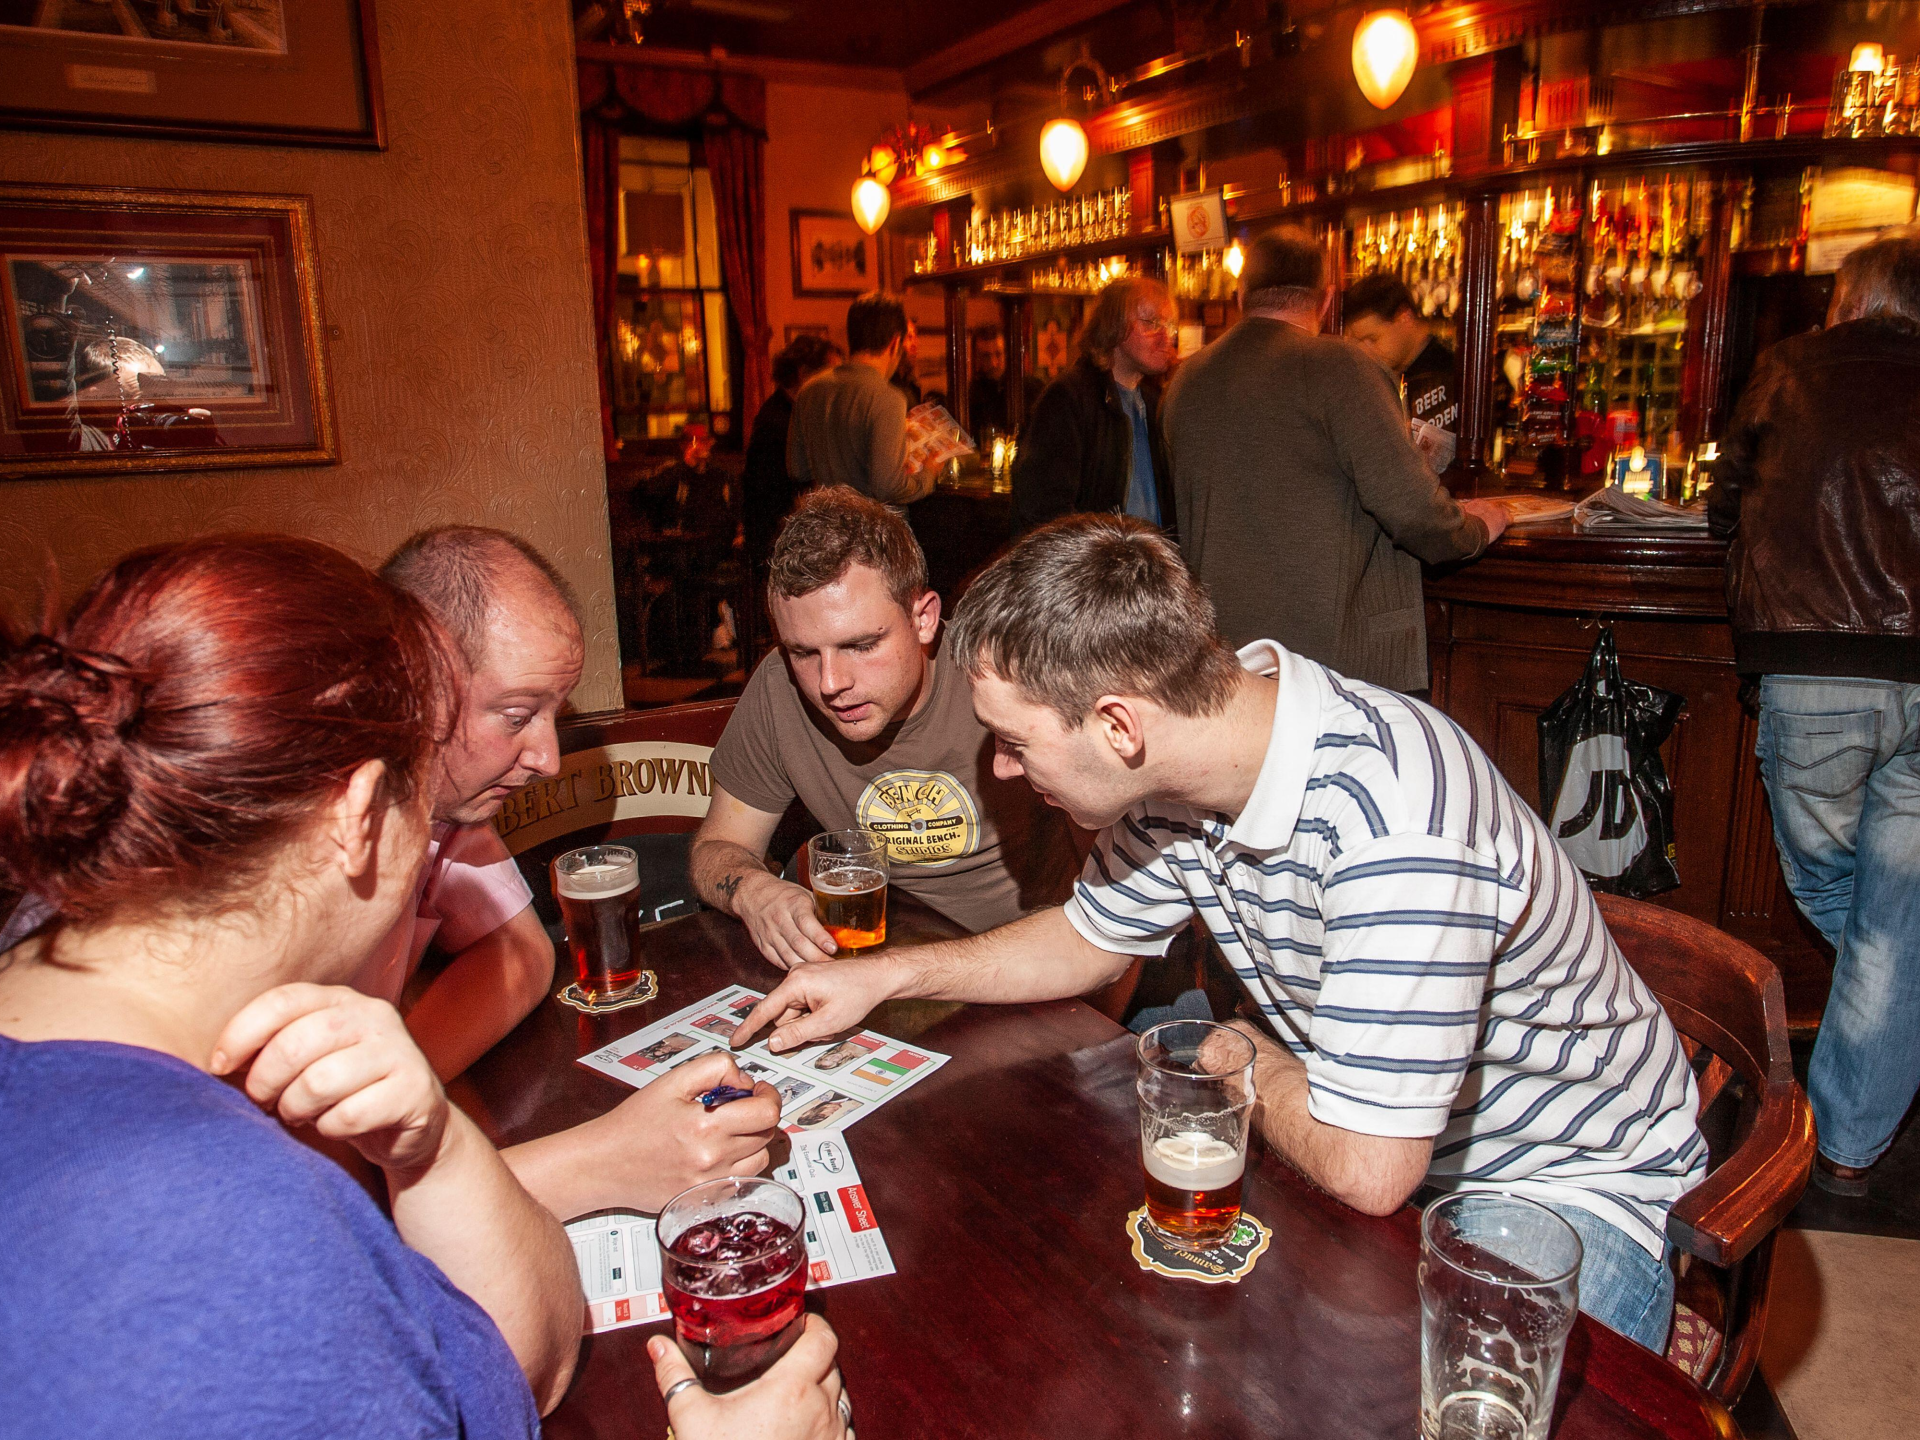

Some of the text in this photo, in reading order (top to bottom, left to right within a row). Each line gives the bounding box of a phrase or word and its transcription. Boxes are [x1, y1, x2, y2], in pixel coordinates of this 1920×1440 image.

[1415, 385, 1447, 415] BEER
[493, 769, 582, 839] BERT
[879, 784, 946, 810] BENCH
[1558, 769, 1638, 841] JD
[873, 818, 957, 830] CLOTHING COMPANY
[885, 835, 924, 846] RIGINAL
[895, 843, 952, 856] STUDIOS
[847, 1187, 862, 1209] Answer
[855, 1209, 871, 1230] Sheet
[1174, 1249, 1226, 1275] Samuel
